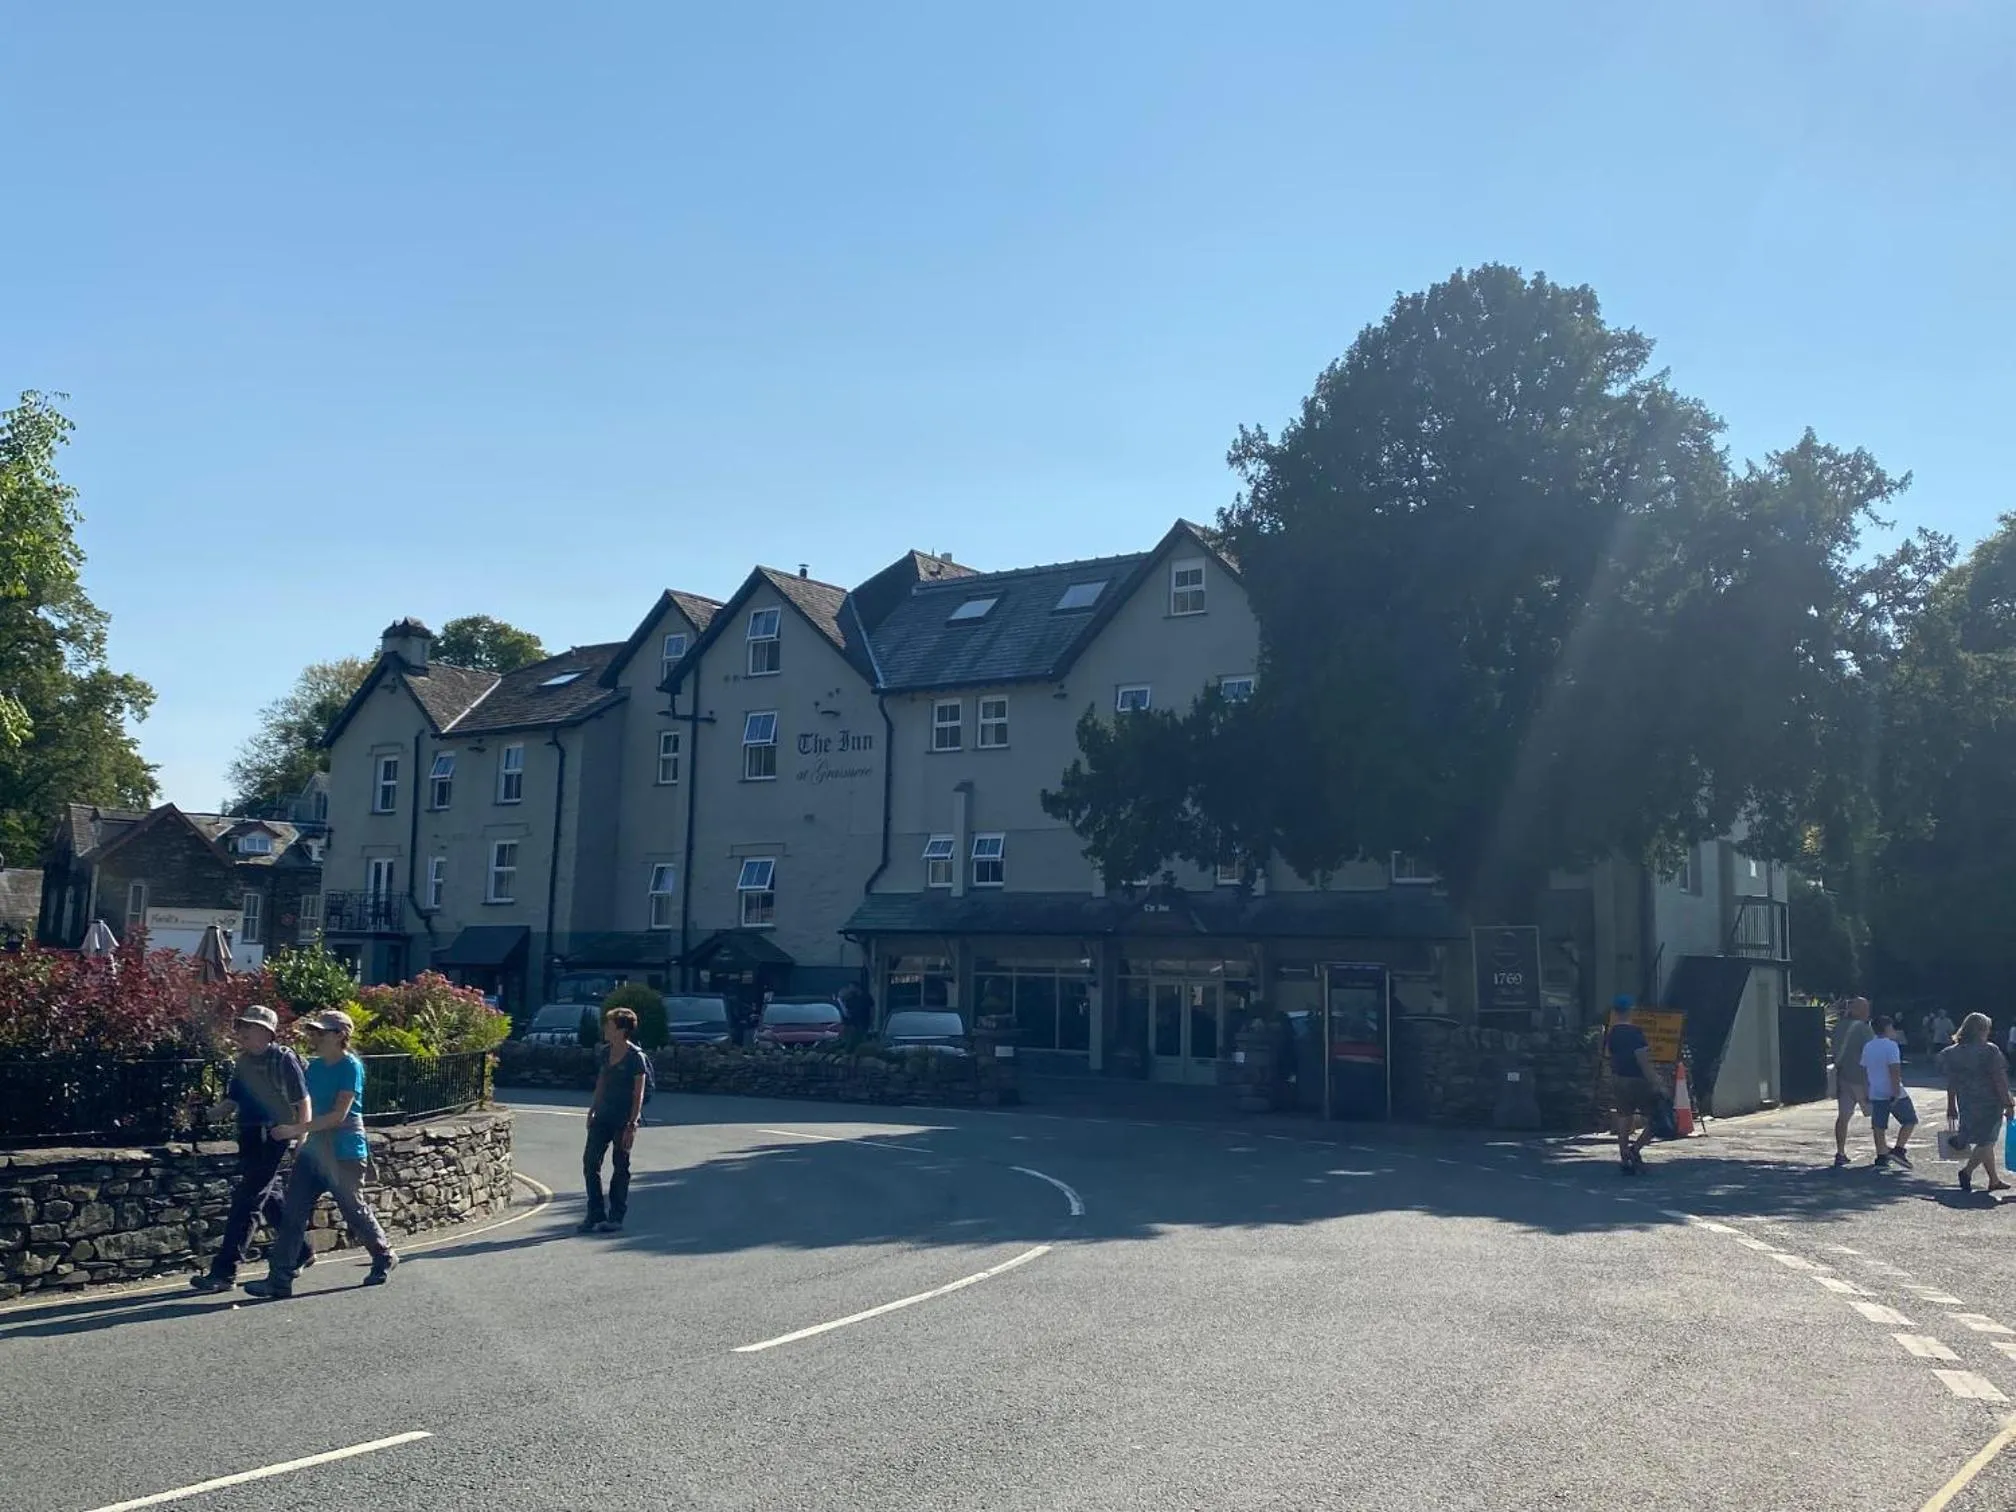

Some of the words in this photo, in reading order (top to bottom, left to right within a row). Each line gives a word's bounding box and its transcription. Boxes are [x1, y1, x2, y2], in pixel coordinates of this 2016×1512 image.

[798, 733, 831, 754] The
[838, 730, 872, 751] Inn
[1494, 972, 1522, 985] 1769
